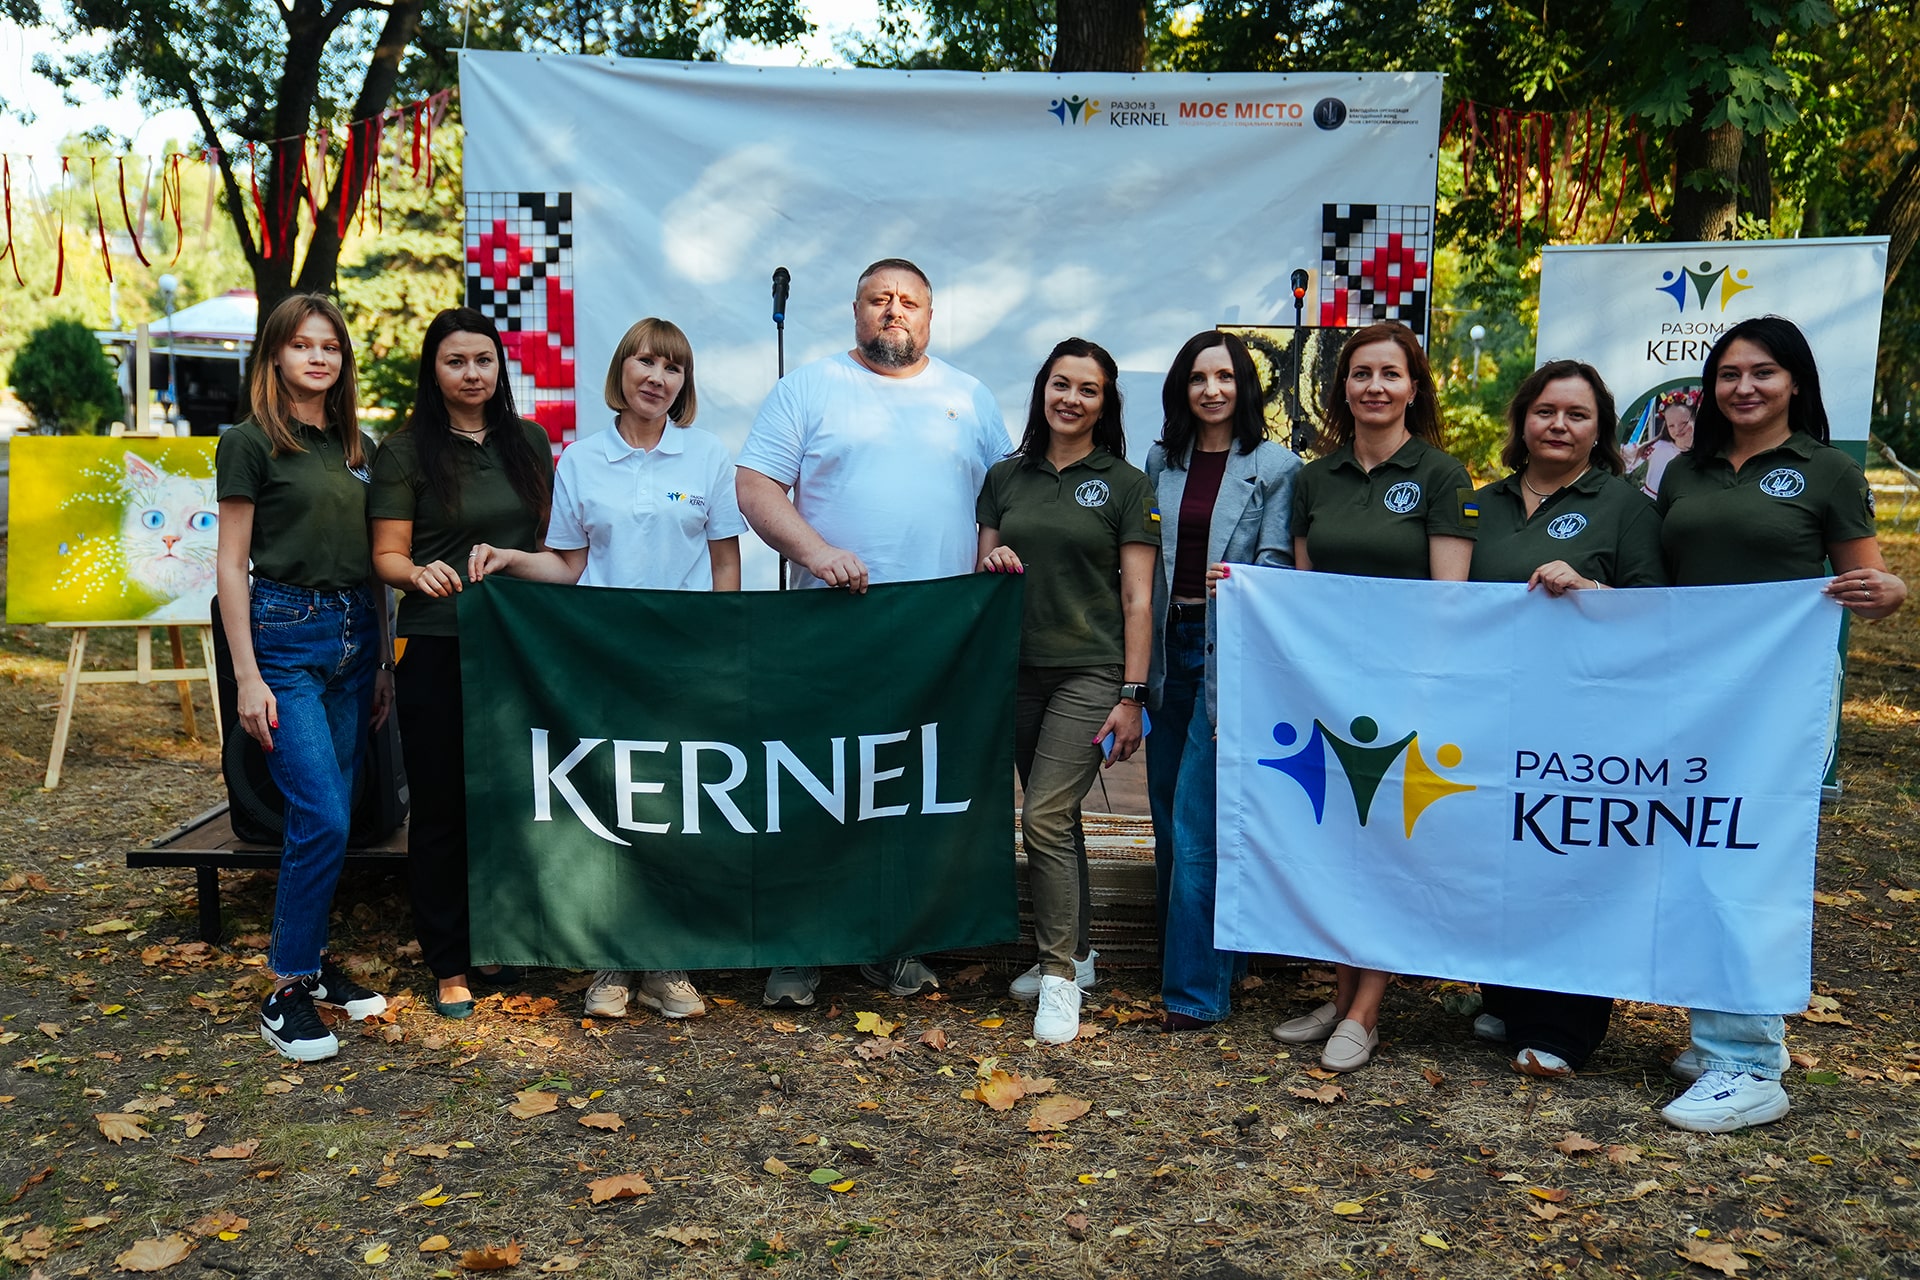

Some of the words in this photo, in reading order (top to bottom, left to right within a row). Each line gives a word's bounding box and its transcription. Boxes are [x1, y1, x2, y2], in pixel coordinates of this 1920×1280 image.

[1110, 101, 1146, 110] РАЗОМ
[1179, 102, 1228, 118] МОЄ
[1235, 103, 1303, 119] МІСТО
[1110, 111, 1169, 128] KERNEL
[1661, 322, 1724, 335] РАЗОМ
[1646, 340, 1714, 366] KERN
[1515, 750, 1669, 786] РАЗОМ
[1683, 757, 1709, 784] З
[530, 722, 972, 846] KERNEL
[1512, 792, 1760, 856] KERNEL
